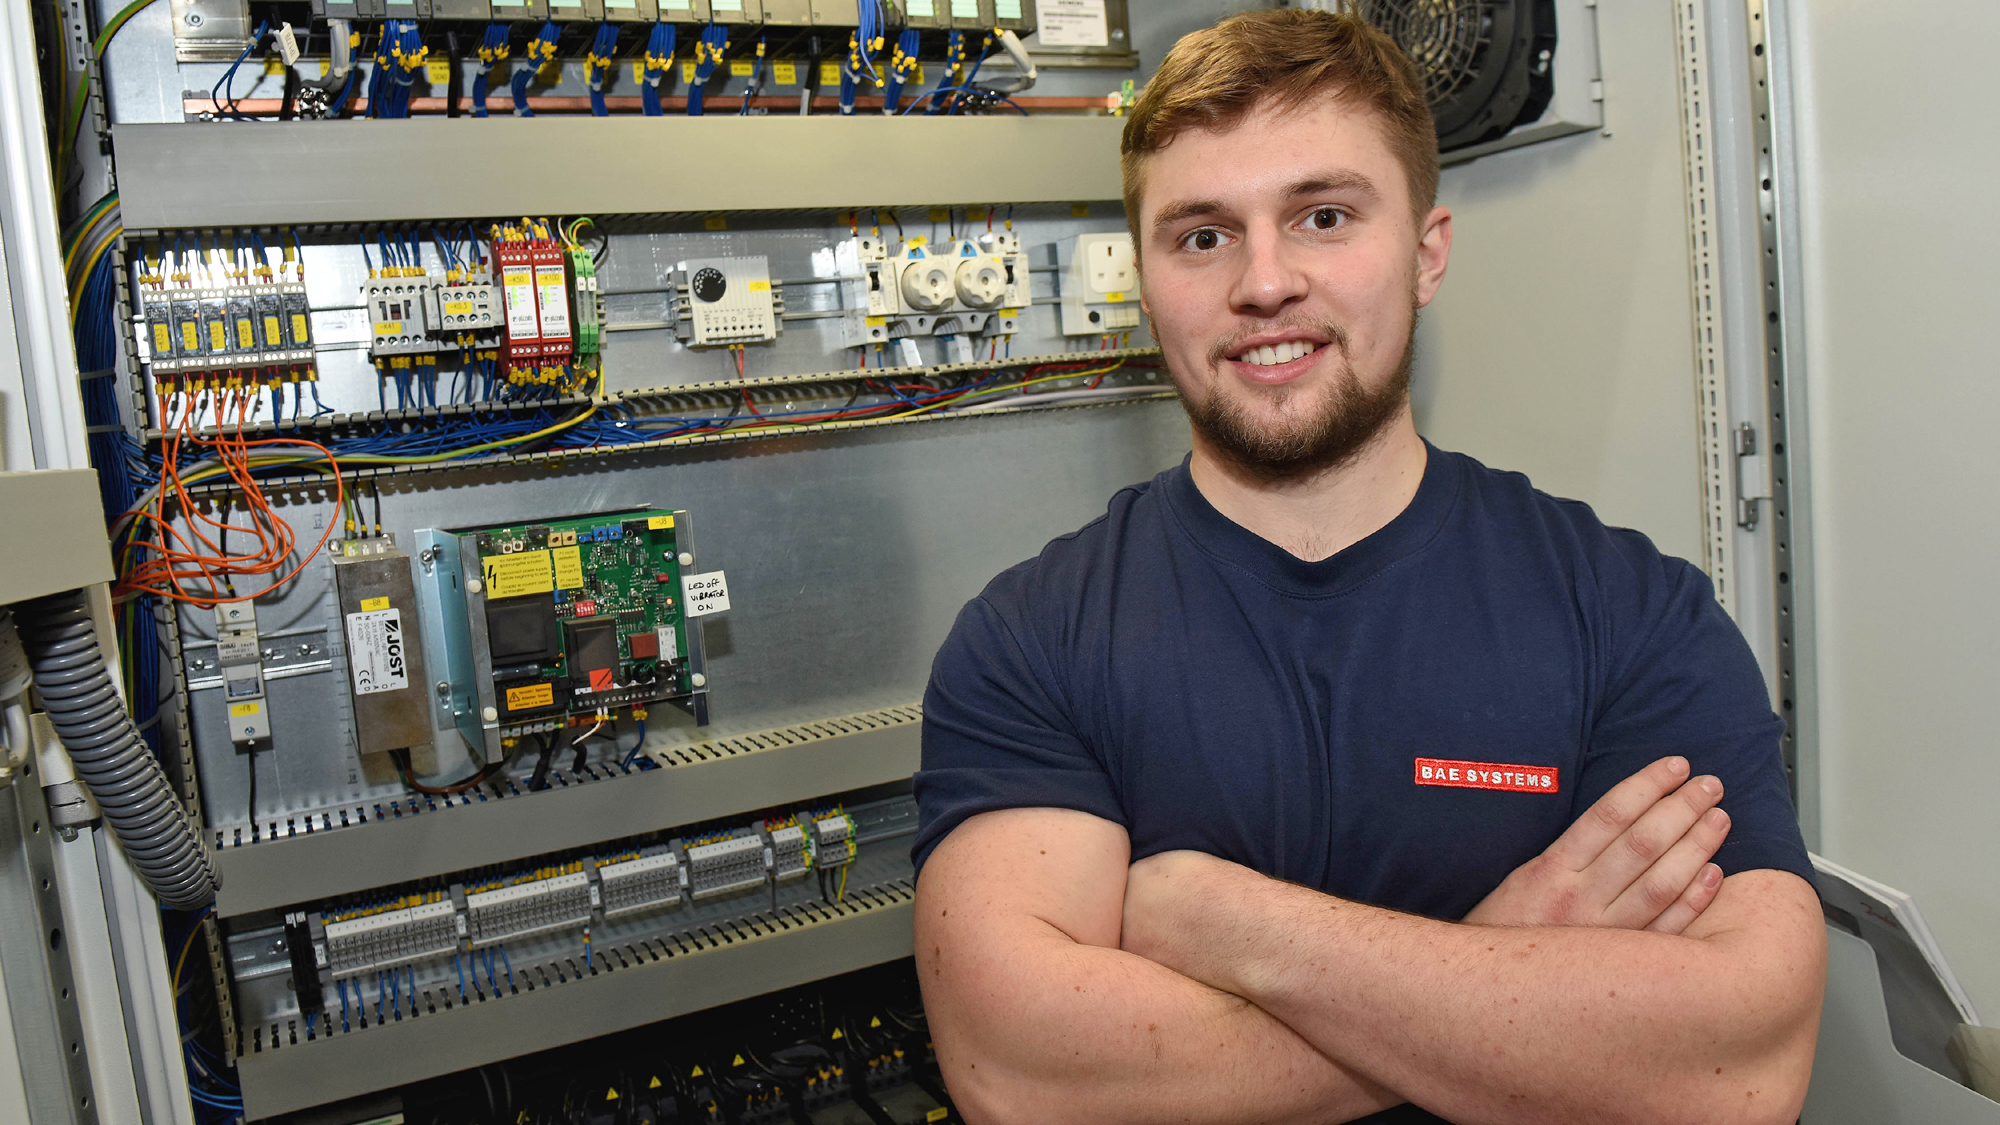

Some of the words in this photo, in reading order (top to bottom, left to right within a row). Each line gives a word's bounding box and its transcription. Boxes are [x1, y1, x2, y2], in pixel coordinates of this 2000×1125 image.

[697, 603, 713, 611] ON
[1421, 765, 1460, 781] BAE
[1466, 769, 1552, 788] SYSTEMS
